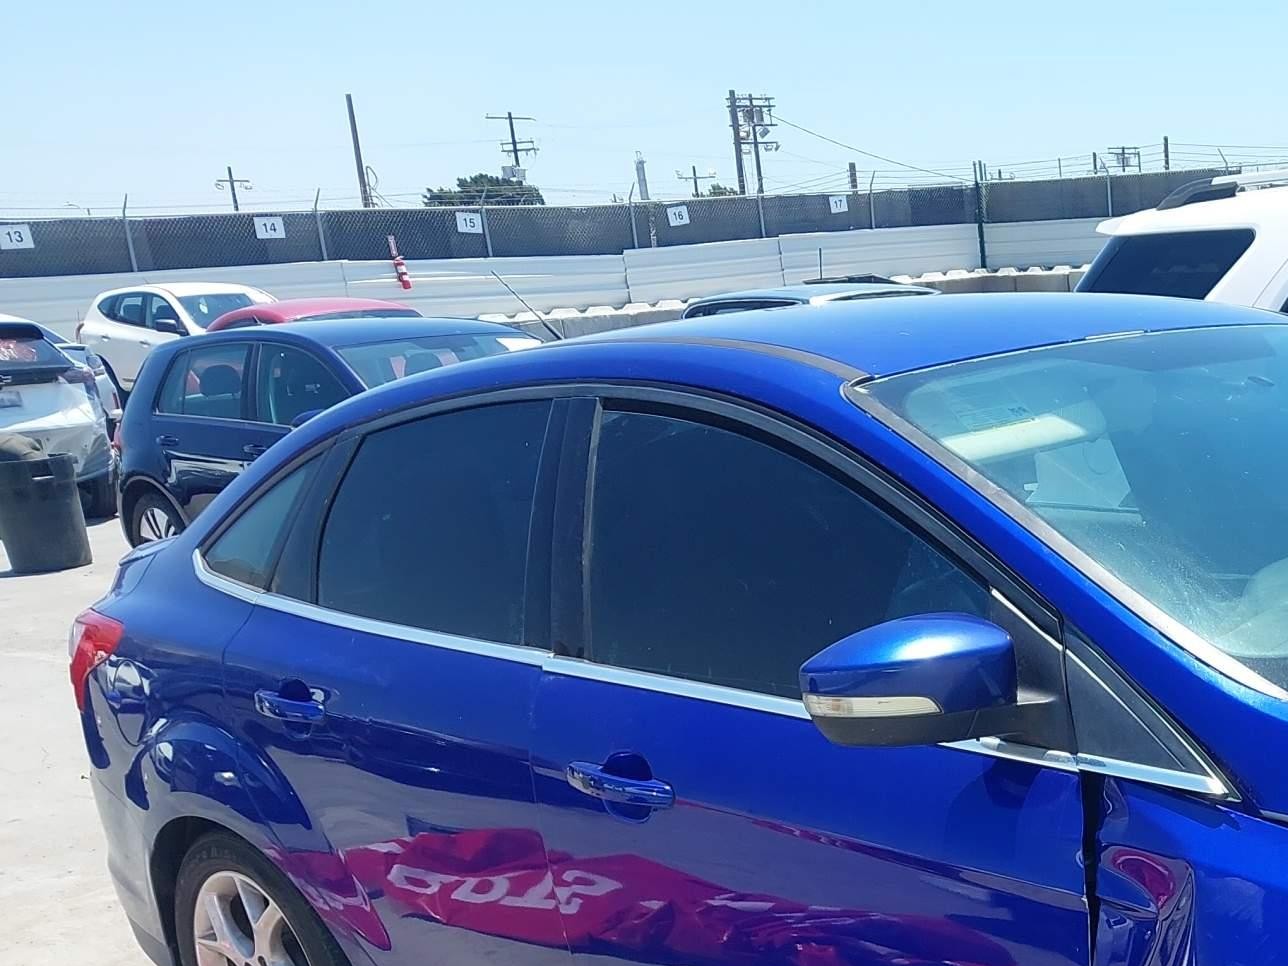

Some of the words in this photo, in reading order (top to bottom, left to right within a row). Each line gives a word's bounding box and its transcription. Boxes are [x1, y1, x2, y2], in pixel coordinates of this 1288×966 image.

[834, 199, 843, 208] 17
[673, 210, 684, 221] 16
[262, 222, 277, 233] 14
[463, 218, 476, 229] 15
[5, 230, 24, 243] 13
